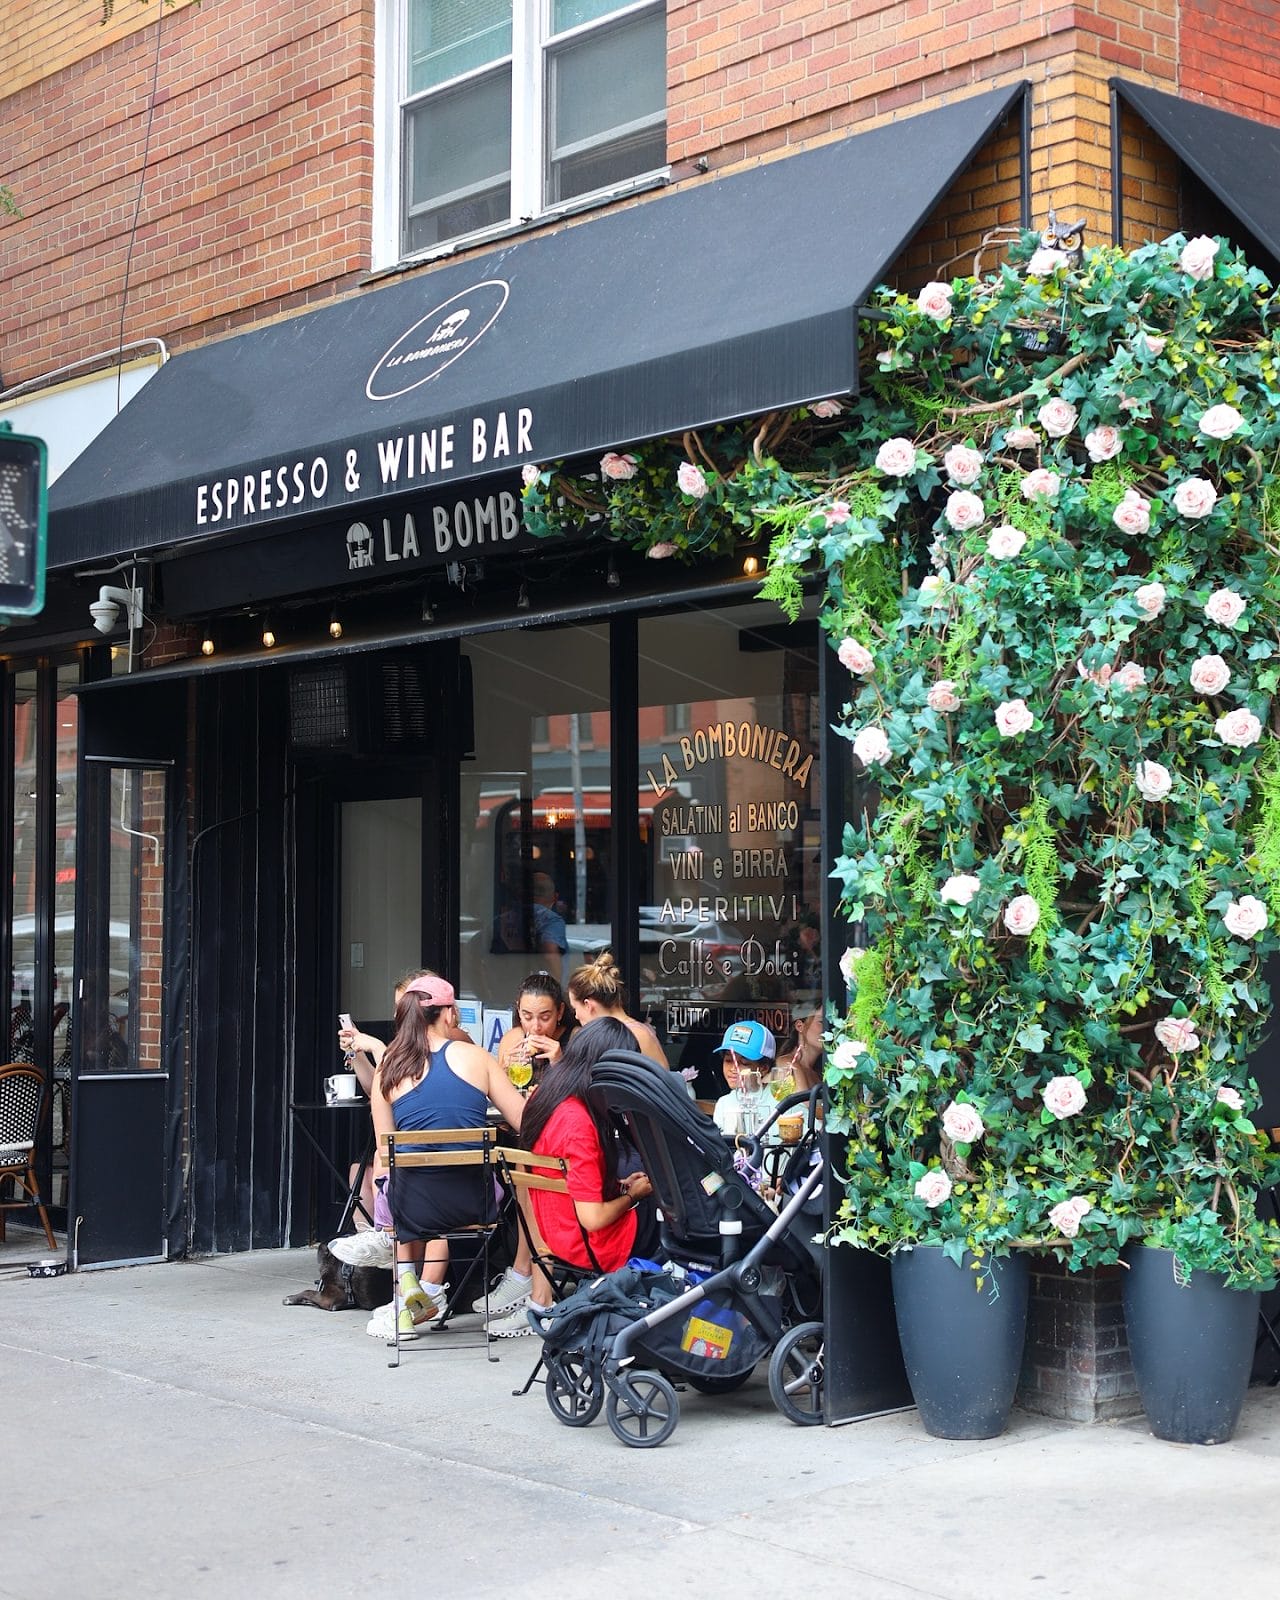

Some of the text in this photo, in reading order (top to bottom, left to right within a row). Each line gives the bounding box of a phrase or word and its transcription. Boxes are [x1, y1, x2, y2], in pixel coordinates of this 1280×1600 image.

[196, 406, 534, 525] ESPRESSO & WINE BAR
[382, 511, 421, 563] LA
[646, 720, 815, 799] LA BOMBONIERA
[661, 800, 799, 836] SALATINI al BANCO
[669, 847, 789, 881] VINI e BIRRA
[659, 893, 799, 923] APERITIVI
[721, 959, 733, 976] e
[739, 933, 800, 977] Dolci
[487, 1016, 504, 1053] A
[671, 1006, 711, 1029] TUTTO
